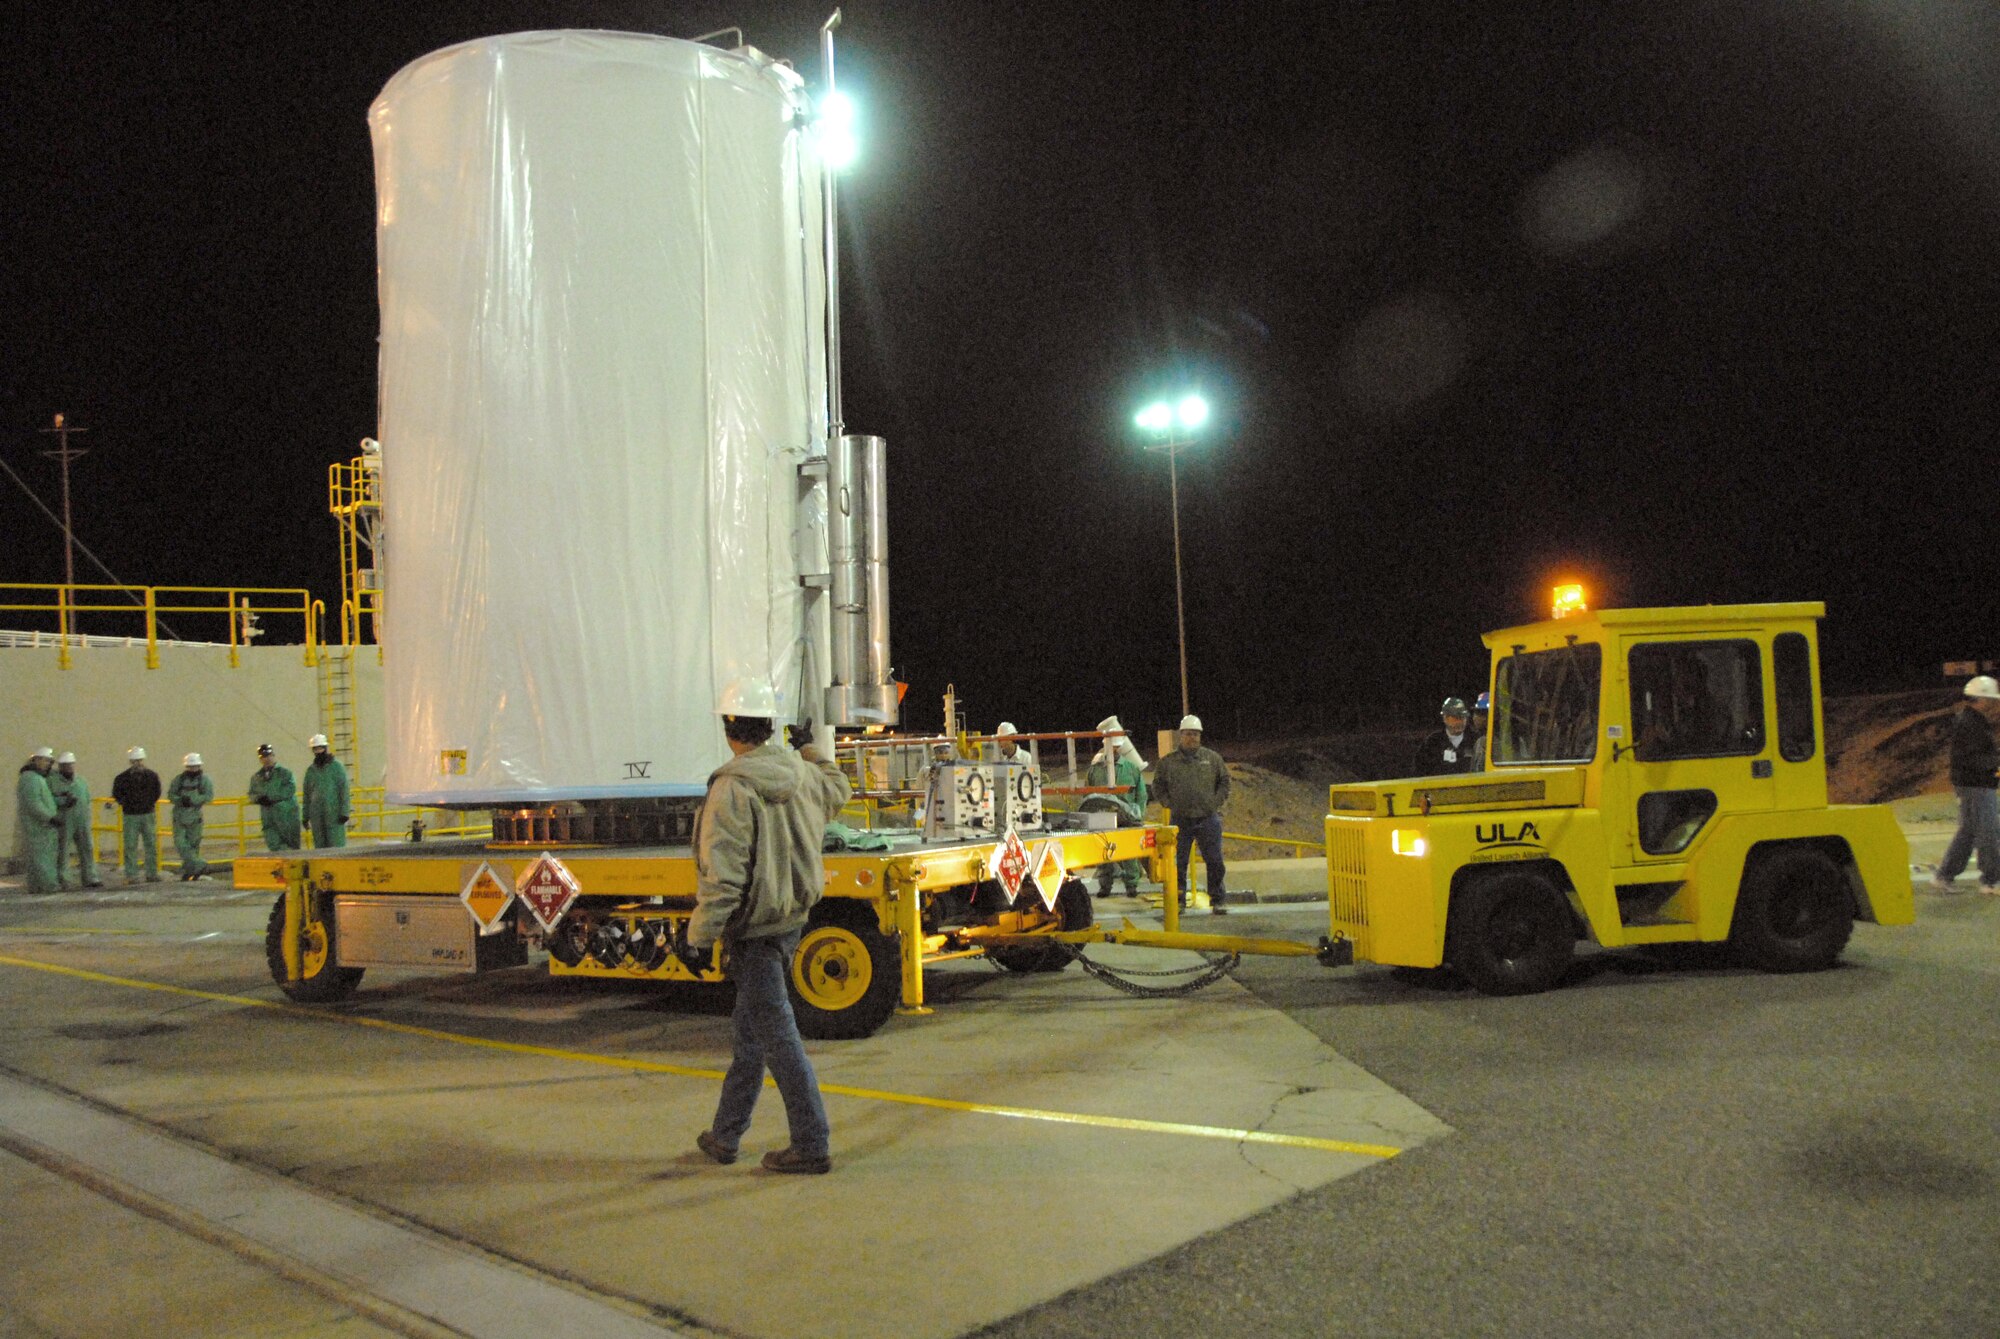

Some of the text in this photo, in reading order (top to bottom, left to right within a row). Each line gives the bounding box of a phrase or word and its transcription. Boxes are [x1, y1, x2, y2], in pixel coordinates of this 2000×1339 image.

[622, 761, 652, 780] IV
[1475, 822, 1540, 843] ULA
[531, 885, 562, 895] FLAMMABLE
[544, 906, 550, 917] 2
